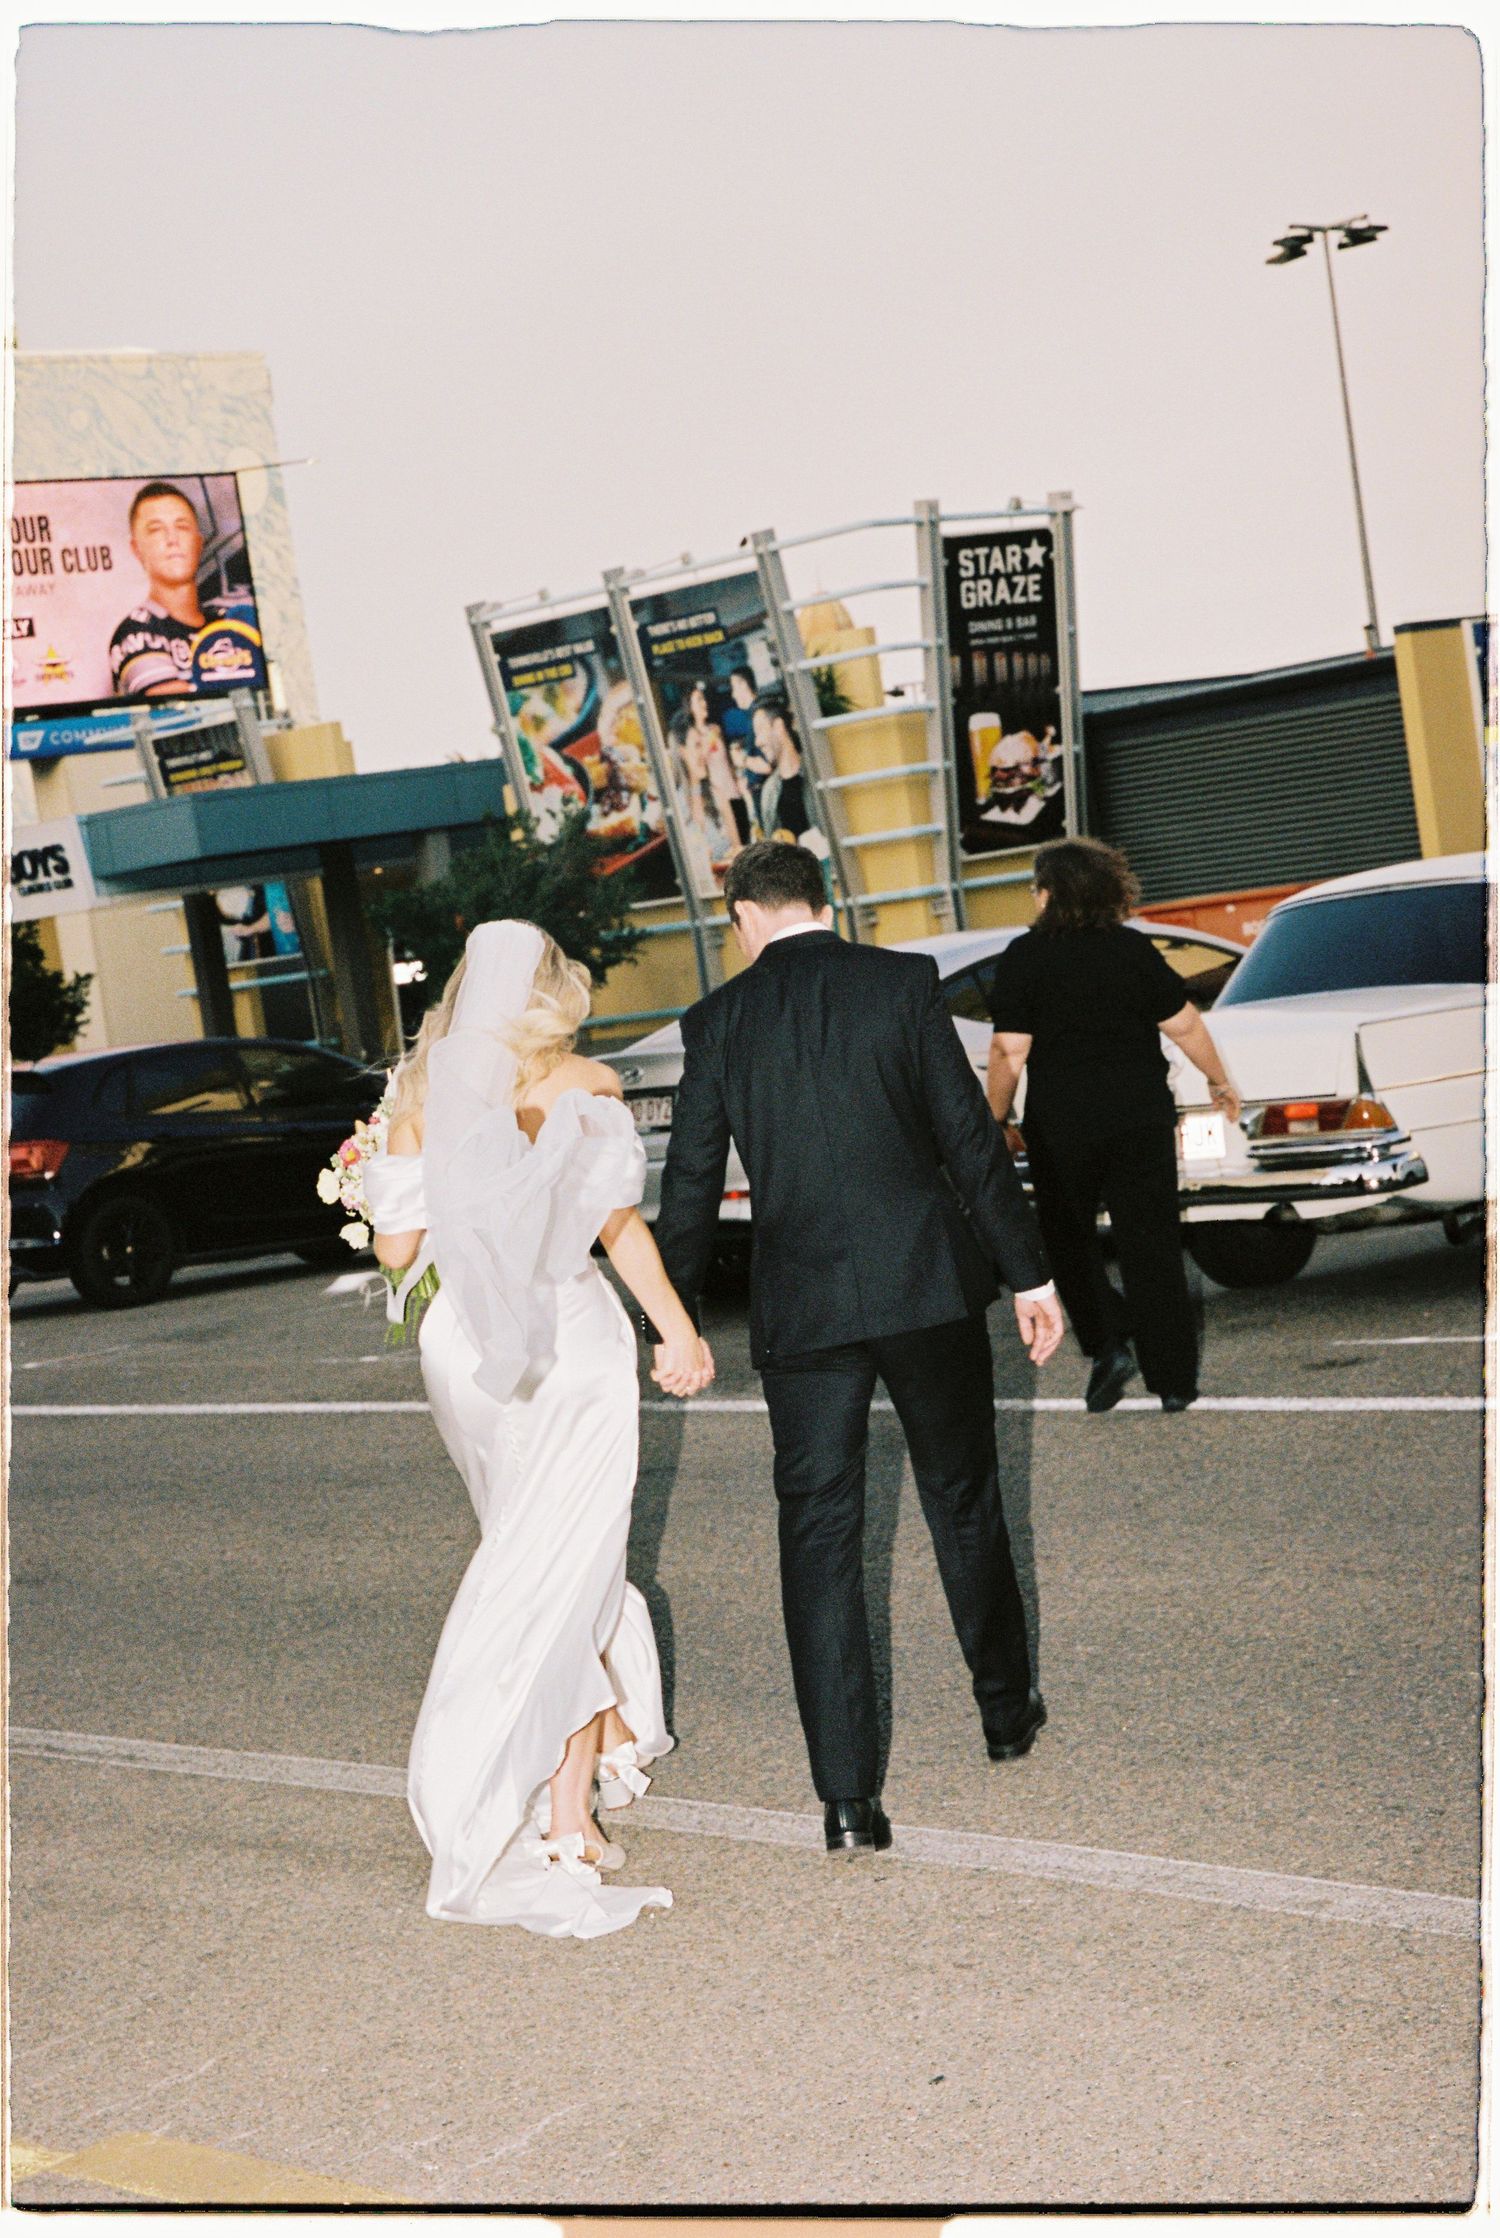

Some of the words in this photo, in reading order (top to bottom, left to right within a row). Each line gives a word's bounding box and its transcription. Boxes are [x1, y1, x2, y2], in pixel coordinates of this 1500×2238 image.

[61, 545, 113, 573] CLUB
[959, 545, 1022, 578] STAR
[961, 573, 1043, 609] GRAZE
